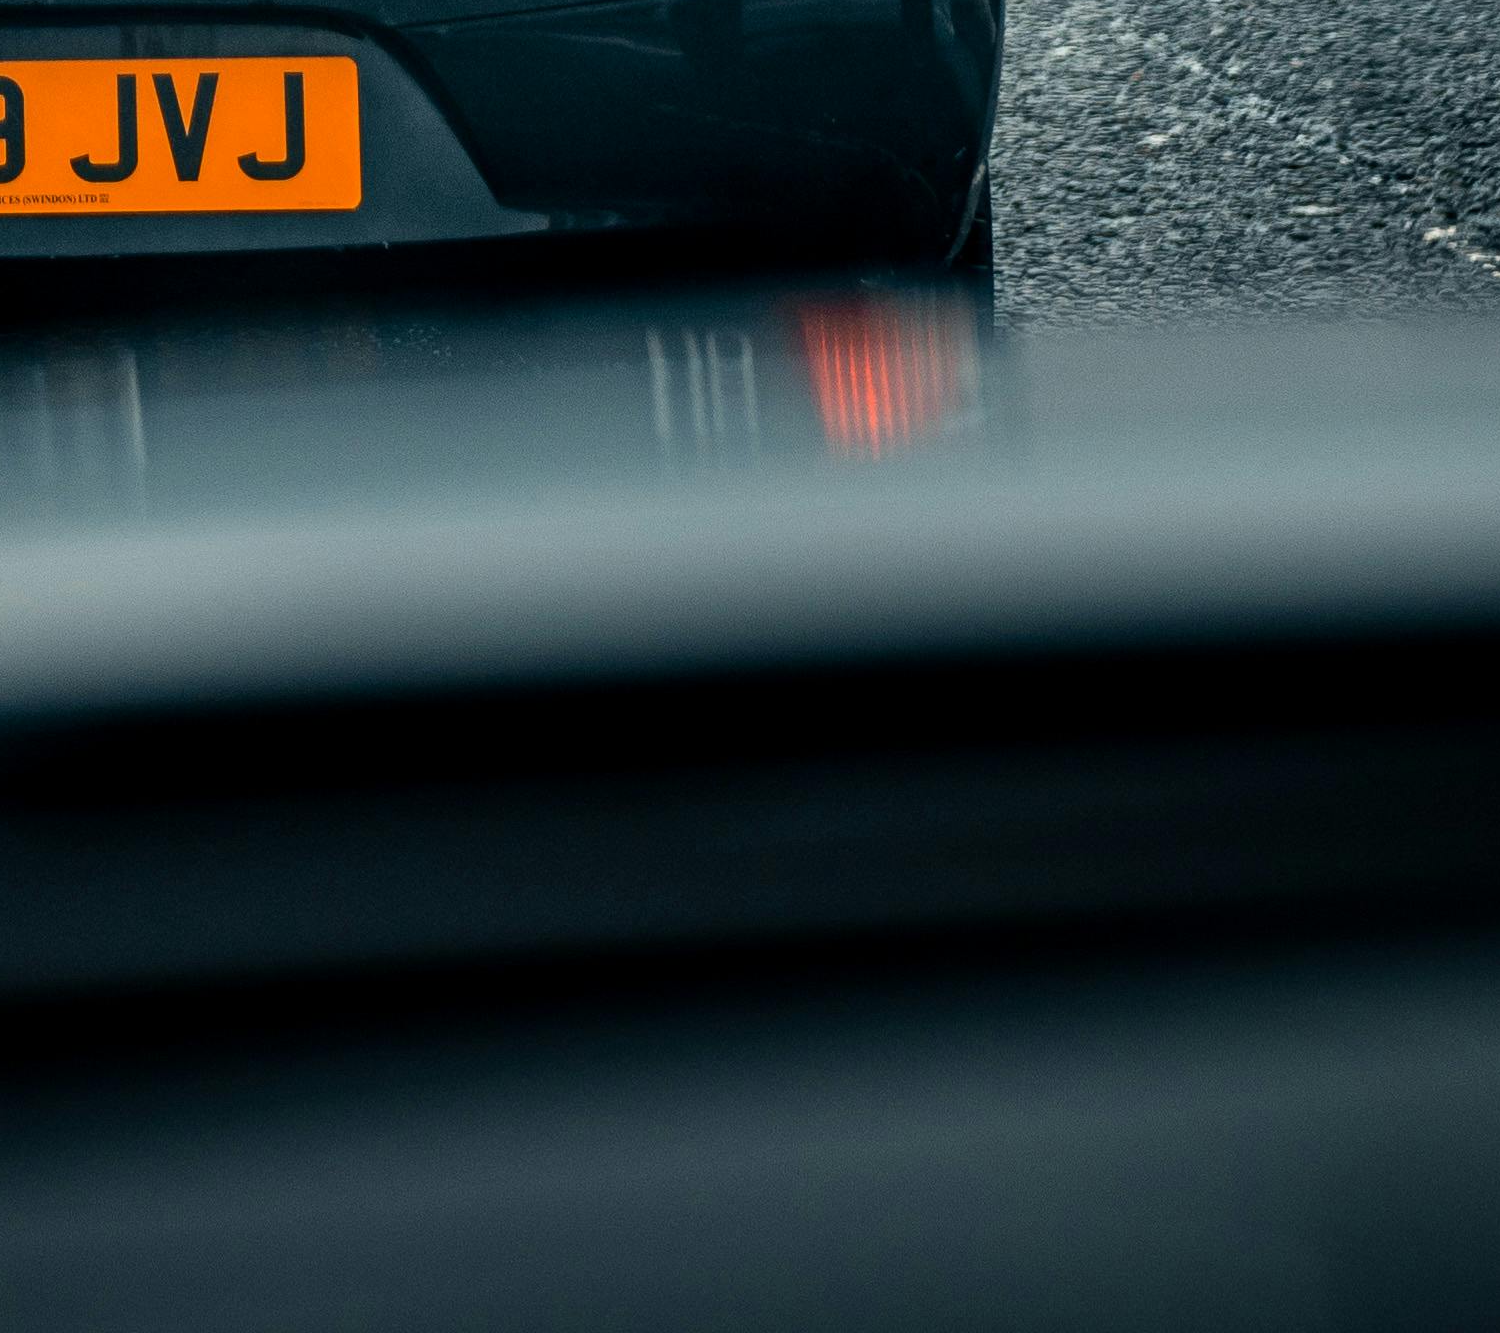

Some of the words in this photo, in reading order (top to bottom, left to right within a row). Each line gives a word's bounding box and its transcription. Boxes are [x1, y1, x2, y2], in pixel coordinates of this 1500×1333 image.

[69, 71, 306, 183] JVJ
[22, 194, 76, 205] (SWINDON)
[78, 194, 98, 204] LTD
